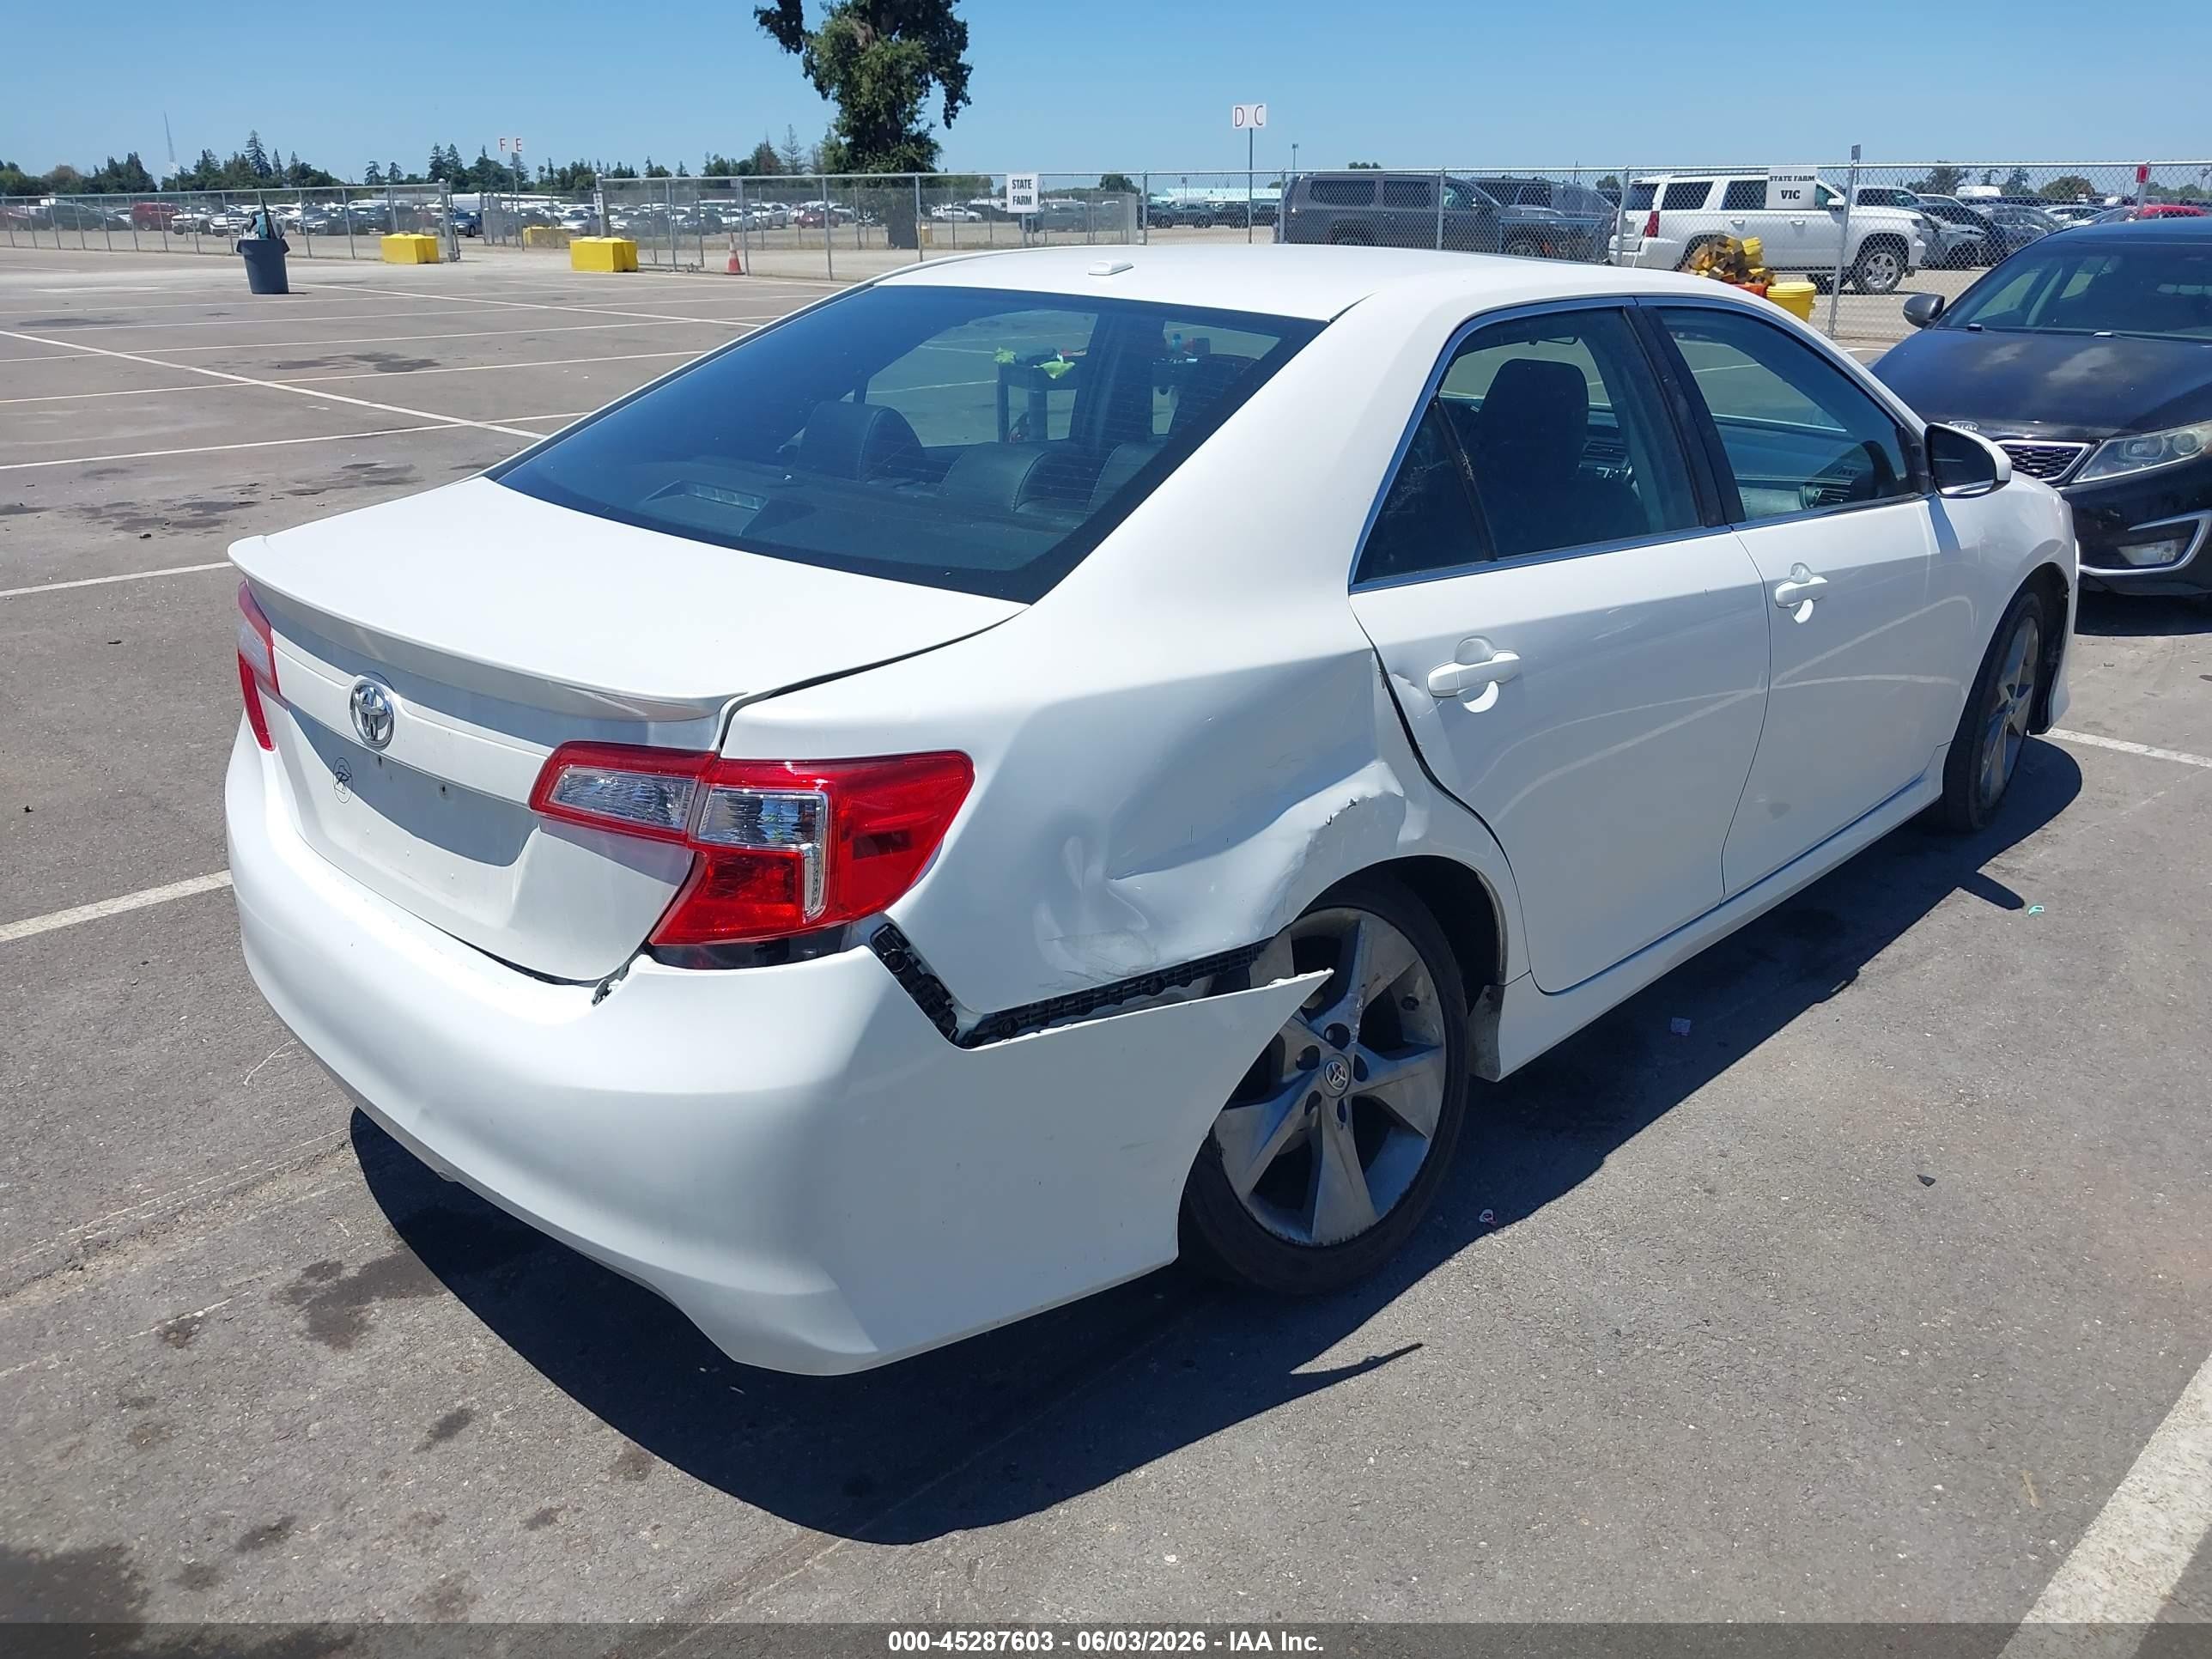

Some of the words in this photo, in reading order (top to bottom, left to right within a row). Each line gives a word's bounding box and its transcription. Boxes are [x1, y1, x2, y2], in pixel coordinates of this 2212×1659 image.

[1235, 106, 1245, 127] D
[1254, 105, 1264, 126] C
[499, 137, 507, 152] F
[515, 137, 523, 152] E
[1012, 179, 1033, 190] STATE
[1012, 195, 1032, 206] FARM
[1780, 190, 1801, 200] VIC
